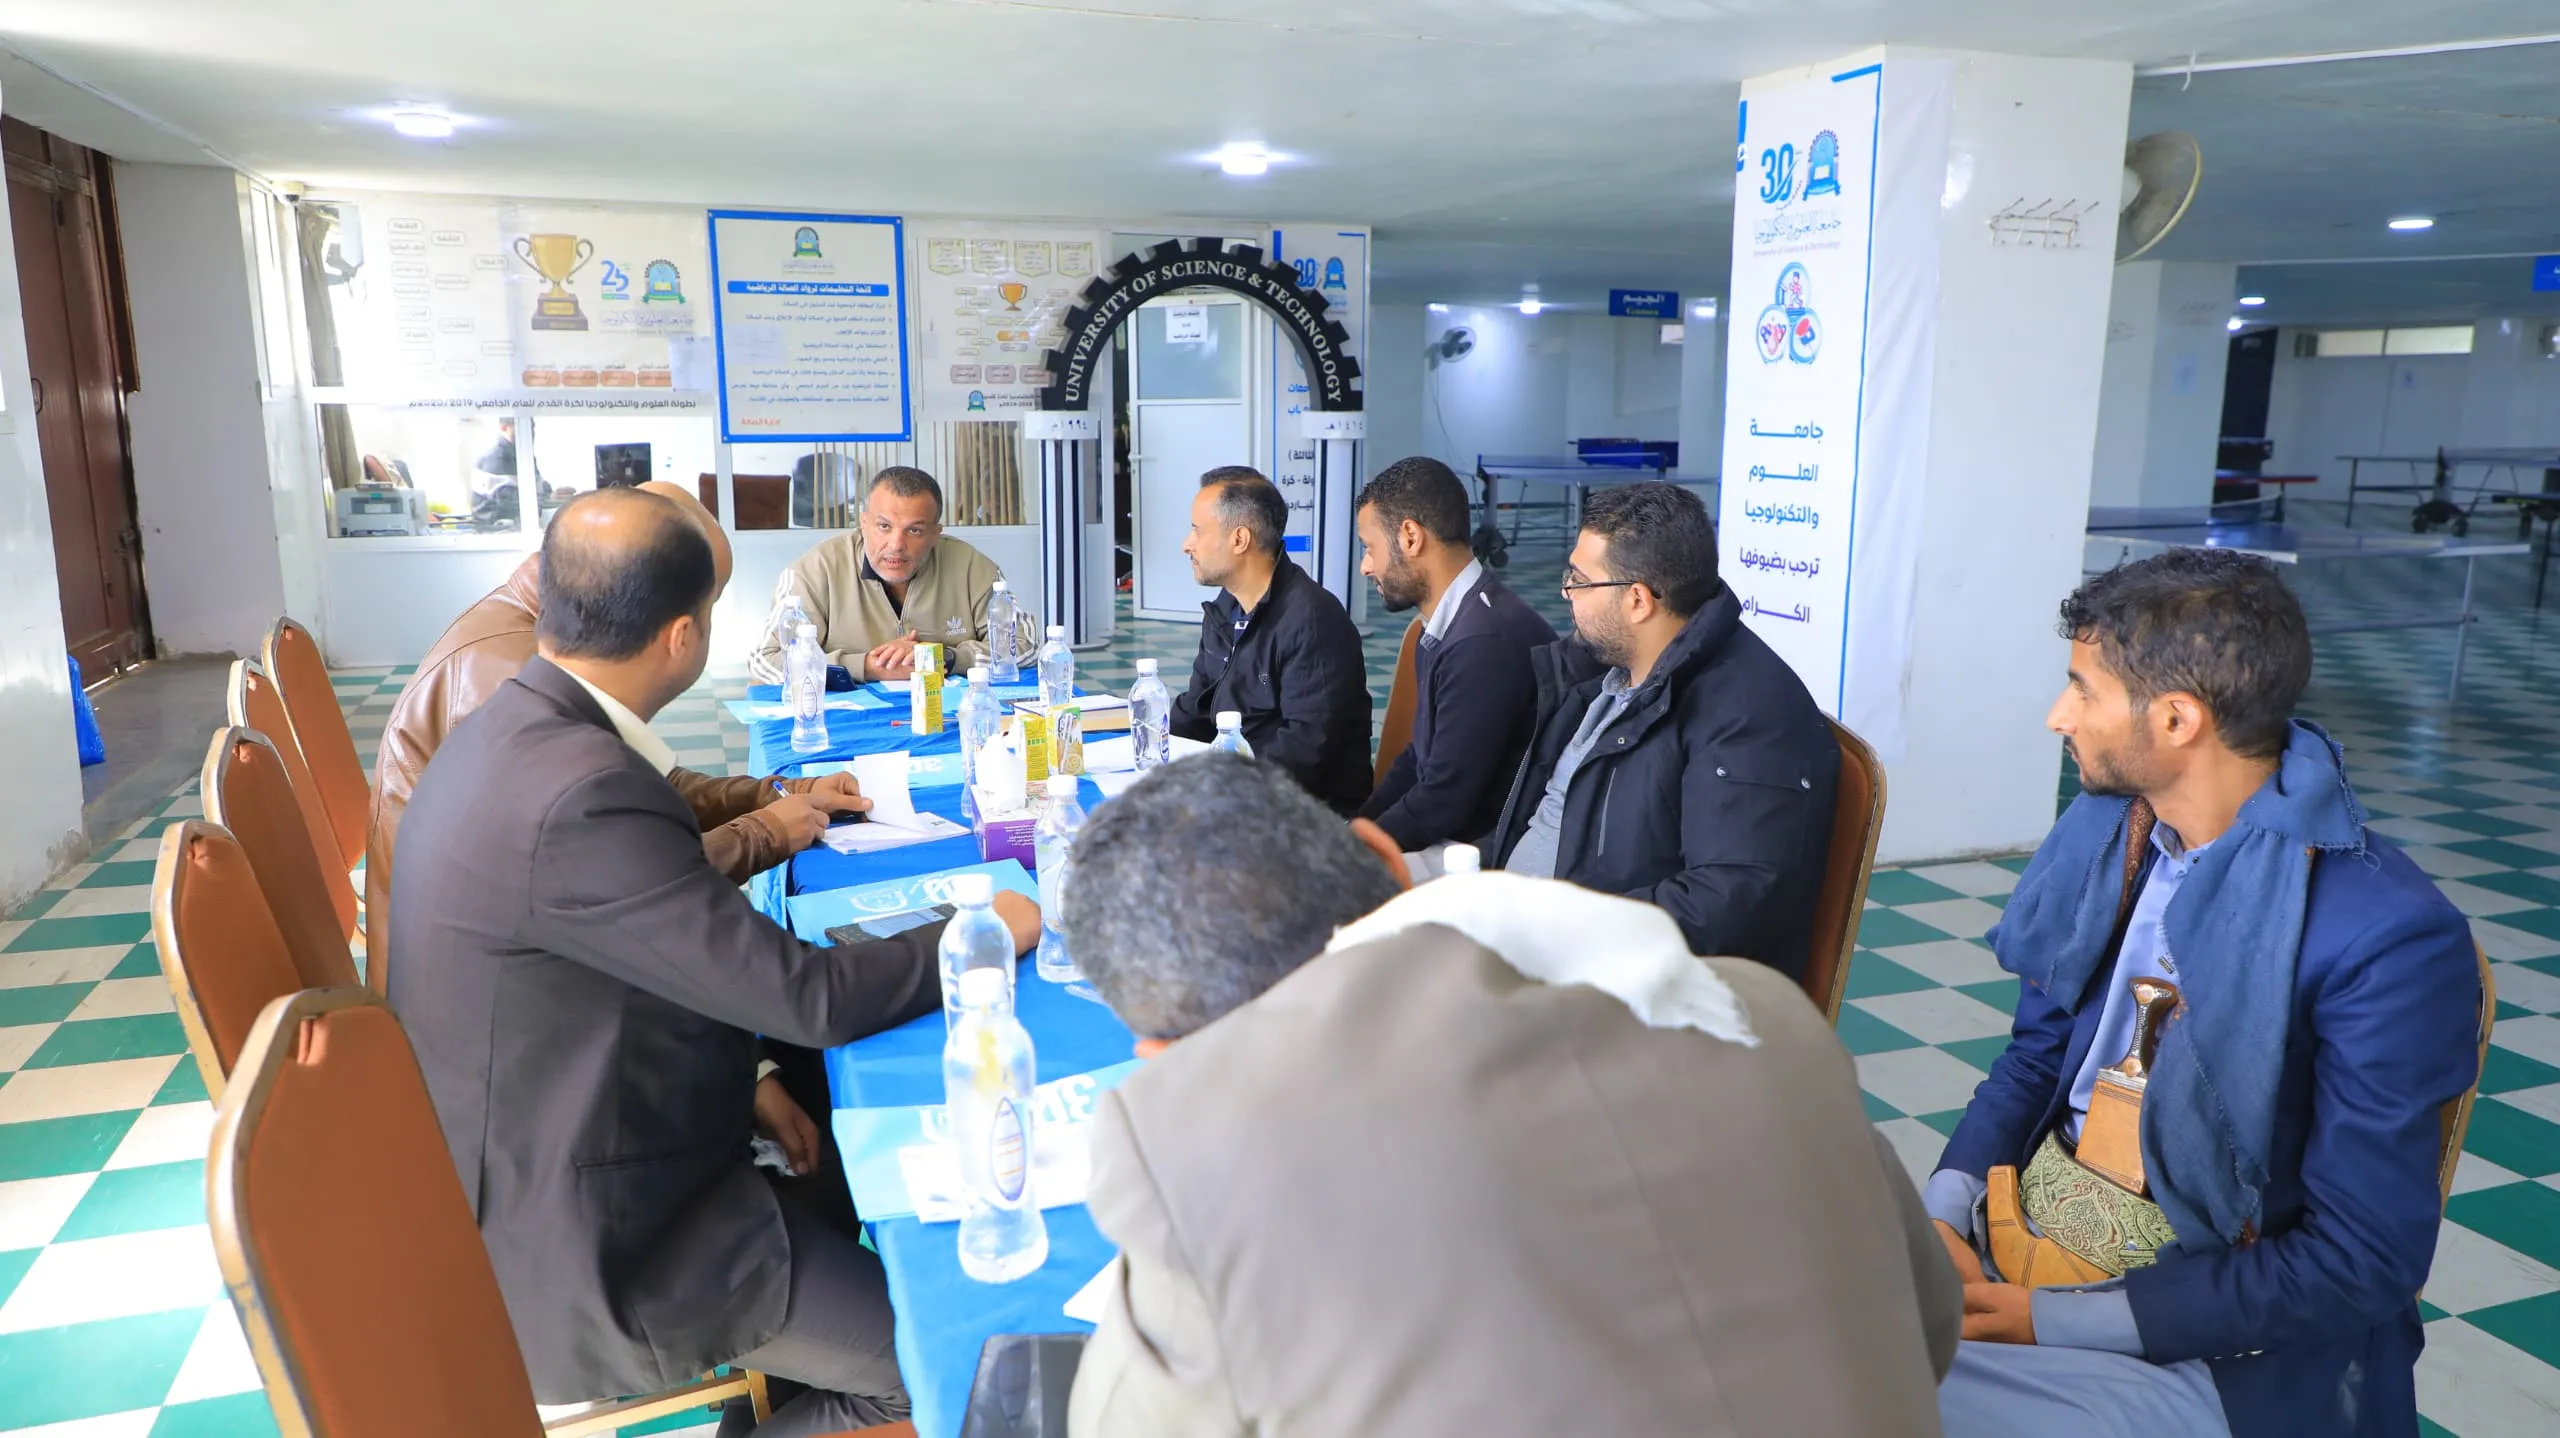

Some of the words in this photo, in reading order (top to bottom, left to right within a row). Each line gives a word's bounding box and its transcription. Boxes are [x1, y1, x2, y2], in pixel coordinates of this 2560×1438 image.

[1760, 143, 1795, 204] 30
[601, 260, 629, 292] 25
[1065, 286, 1131, 403] UNIVERSITY
[1132, 270, 1157, 293] OF
[1161, 259, 1248, 282] SCIENCE
[1247, 273, 1263, 288] &
[1266, 279, 1342, 403] TECHNOLOGY
[1750, 418, 1824, 444] جامعة
[1748, 462, 1819, 483] العلوم
[1744, 499, 1820, 530] والتكنولوجيا
[1739, 546, 1787, 576] بضيوفها
[1788, 557, 1821, 579] ترحب
[1742, 595, 1811, 624] الكرام
